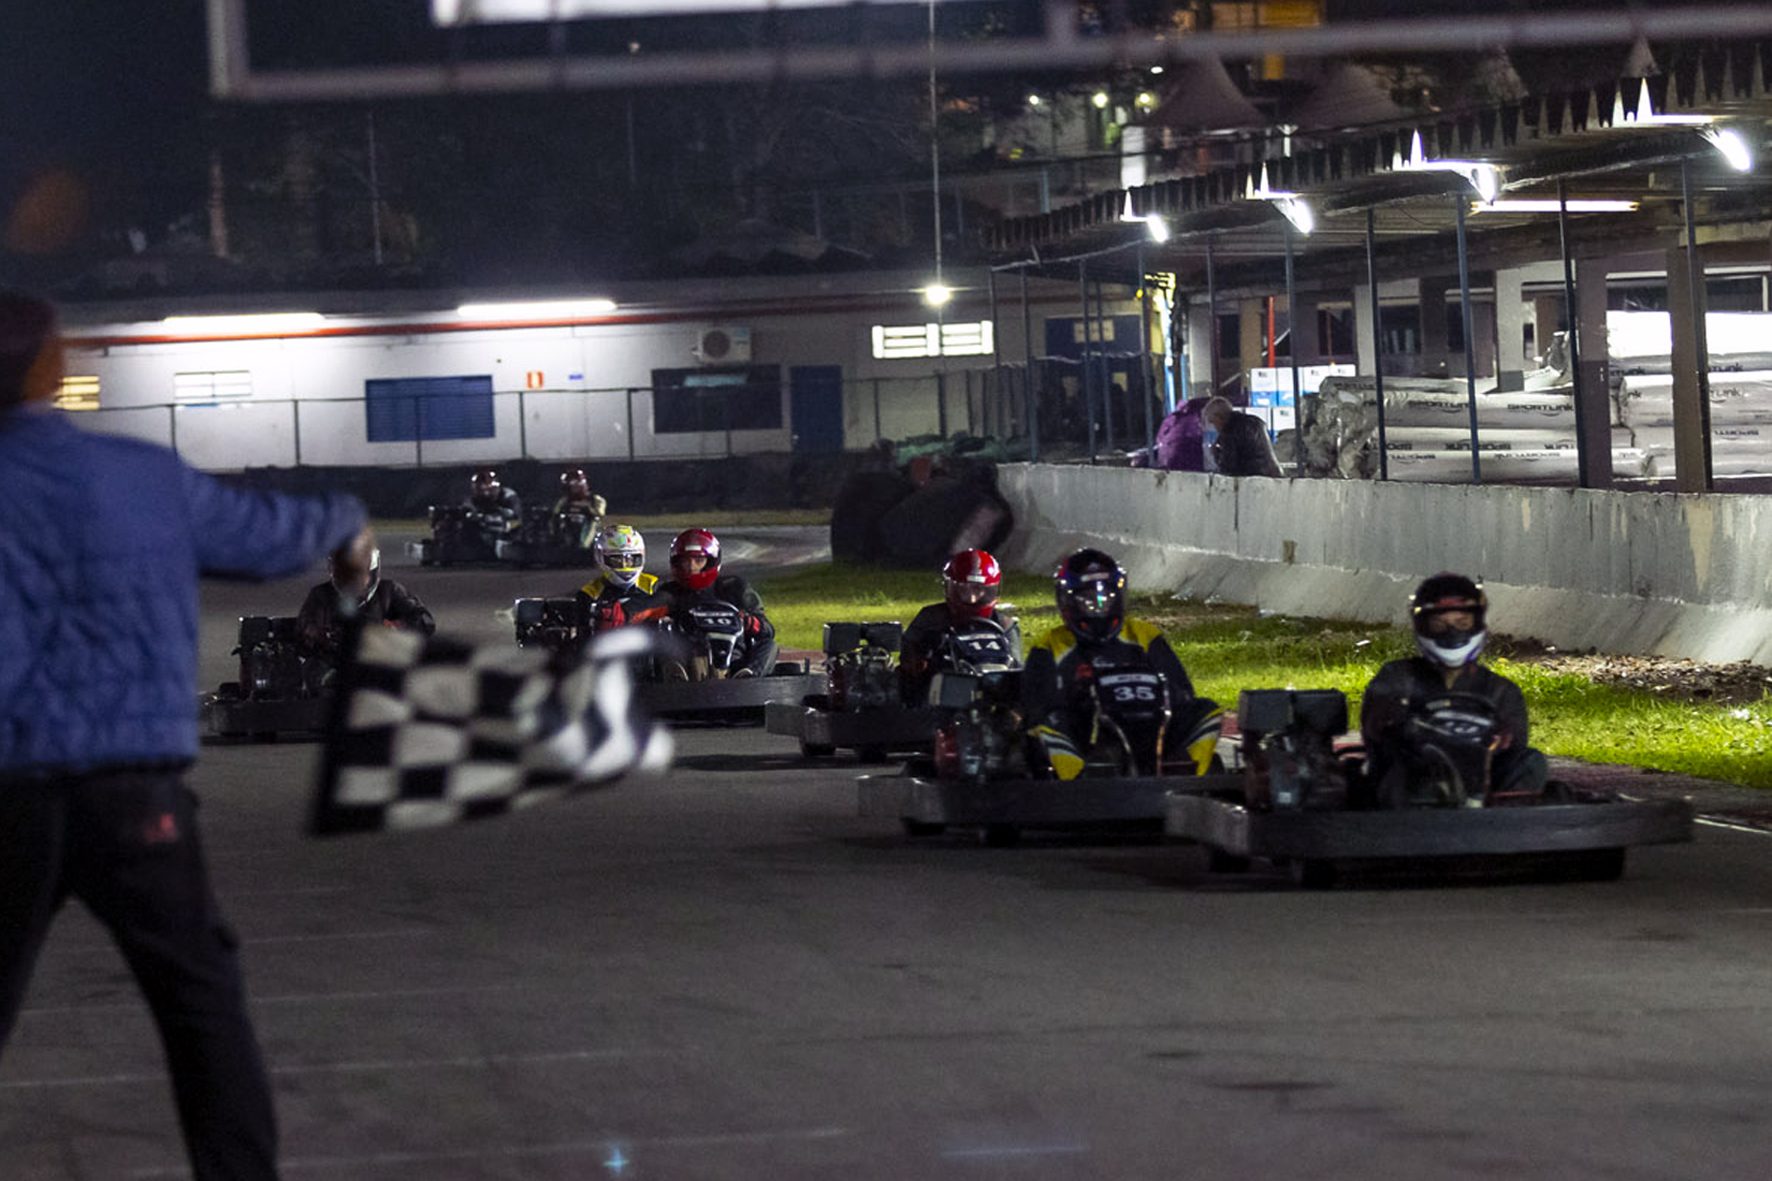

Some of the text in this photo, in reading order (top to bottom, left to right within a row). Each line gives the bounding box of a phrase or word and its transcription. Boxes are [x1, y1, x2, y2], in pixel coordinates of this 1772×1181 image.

[704, 617, 732, 625] 10
[968, 641, 1001, 651] 14
[1113, 685, 1157, 702] 35
